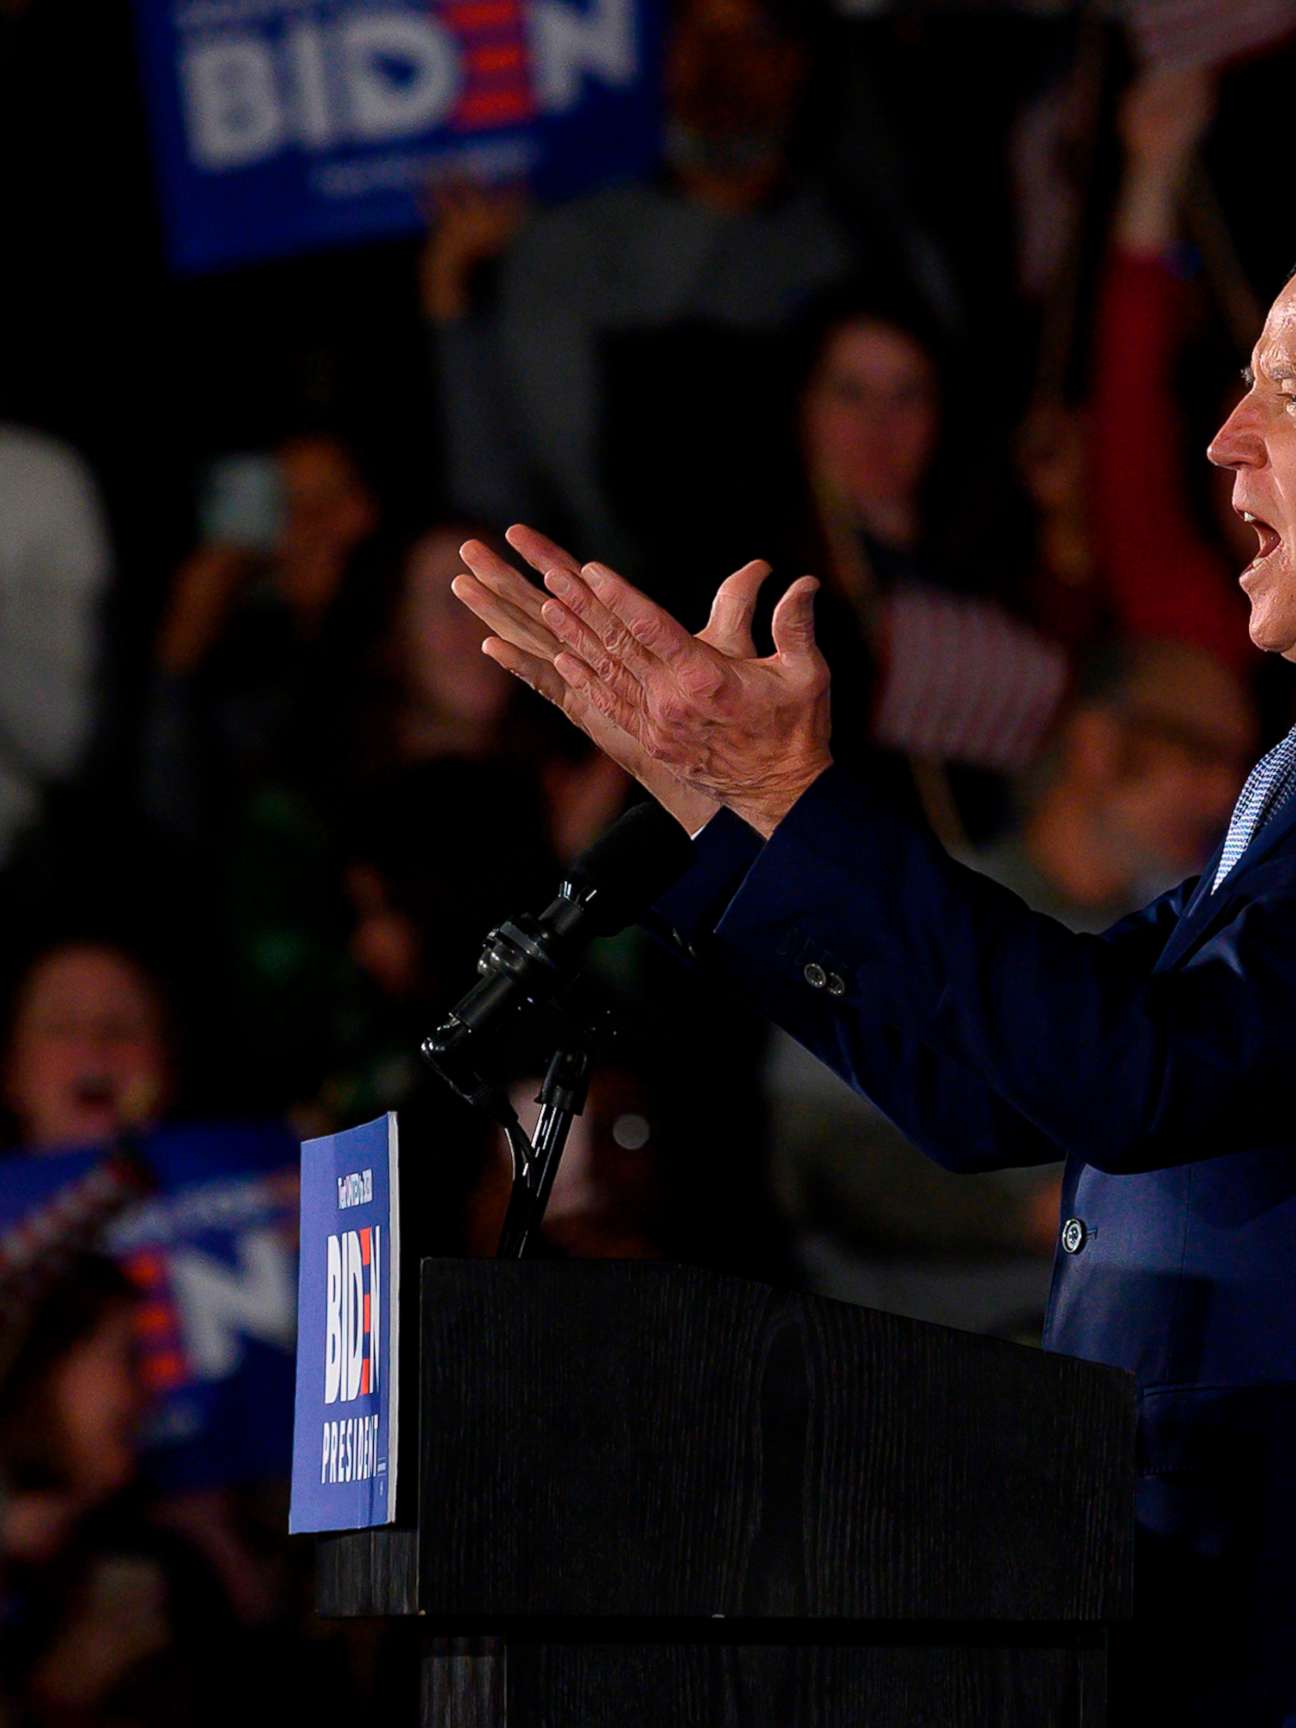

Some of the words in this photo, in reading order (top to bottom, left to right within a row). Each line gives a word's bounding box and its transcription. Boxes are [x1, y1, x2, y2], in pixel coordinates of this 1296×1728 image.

[181, 0, 639, 172] BIDEN
[324, 1226, 381, 1404] BIDEN
[321, 1414, 379, 1484] PRESIDENT
